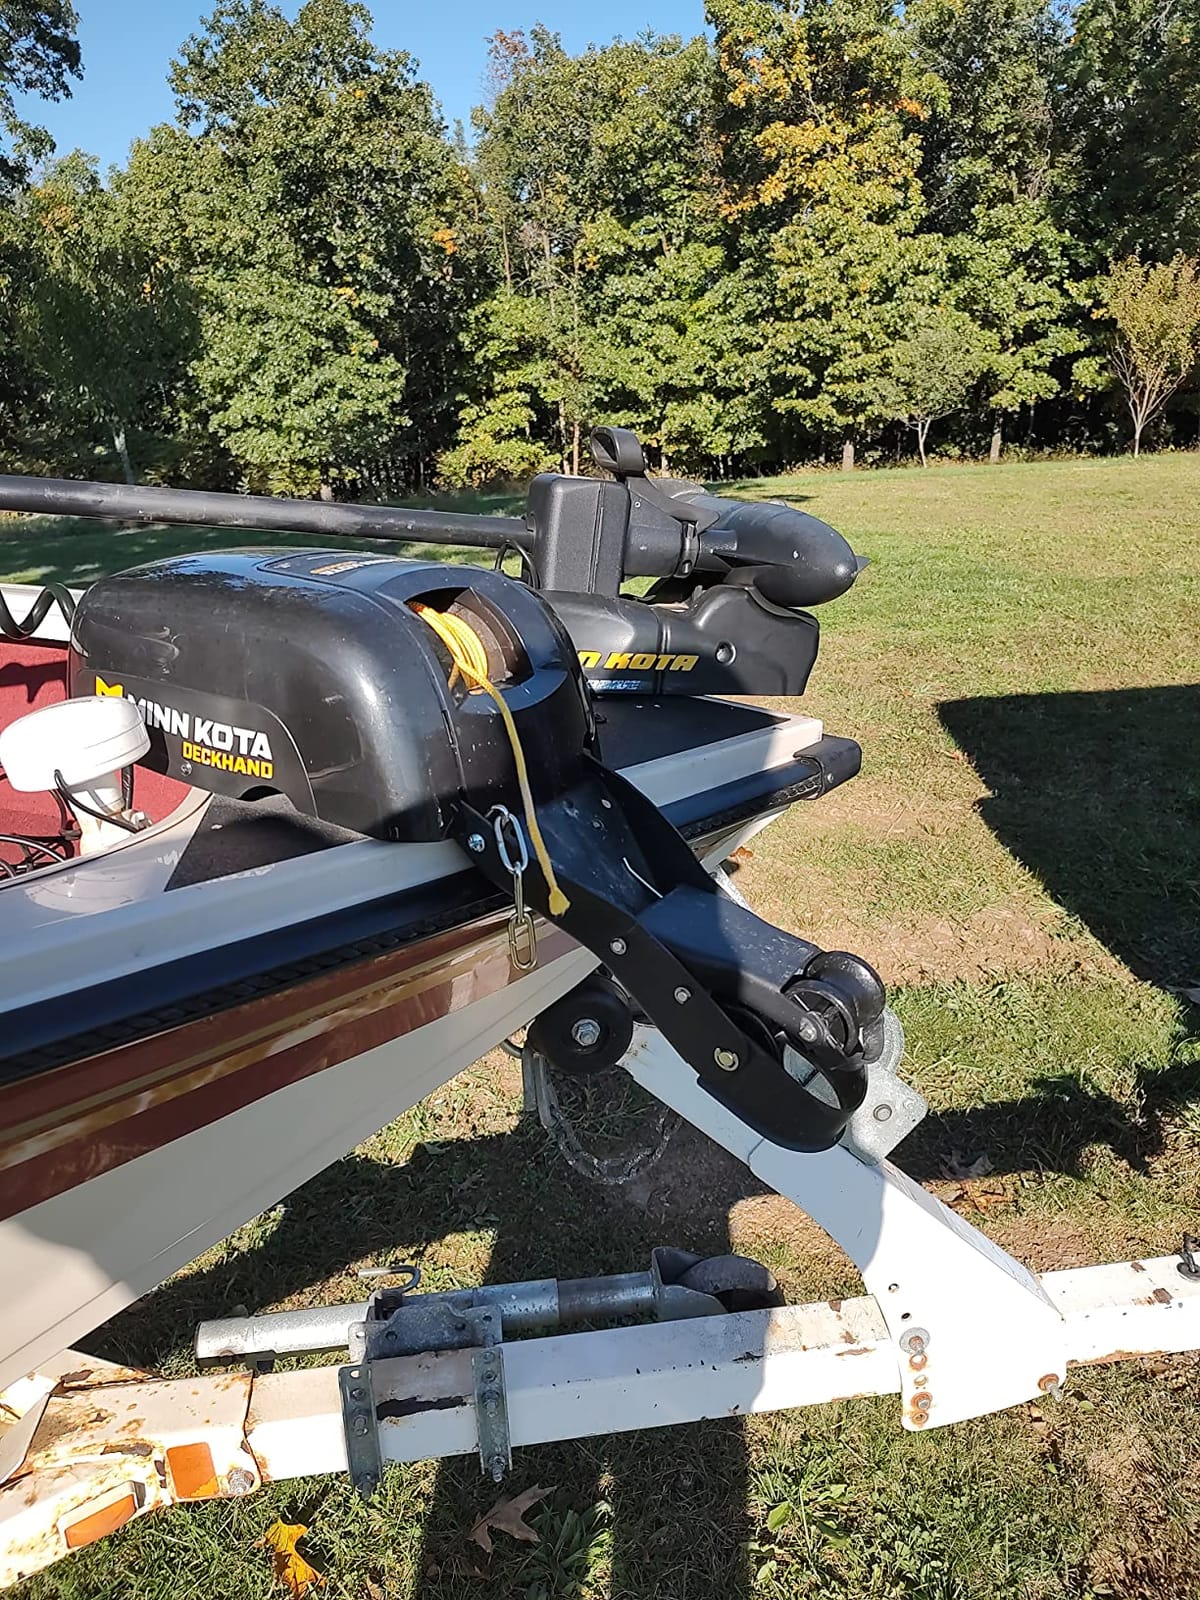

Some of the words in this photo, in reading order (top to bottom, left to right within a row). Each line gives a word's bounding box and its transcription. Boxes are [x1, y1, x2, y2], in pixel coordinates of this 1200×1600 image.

[604, 651, 699, 672] KOTA
[194, 716, 273, 761] KOTA
[182, 740, 274, 780] DECKHAND
